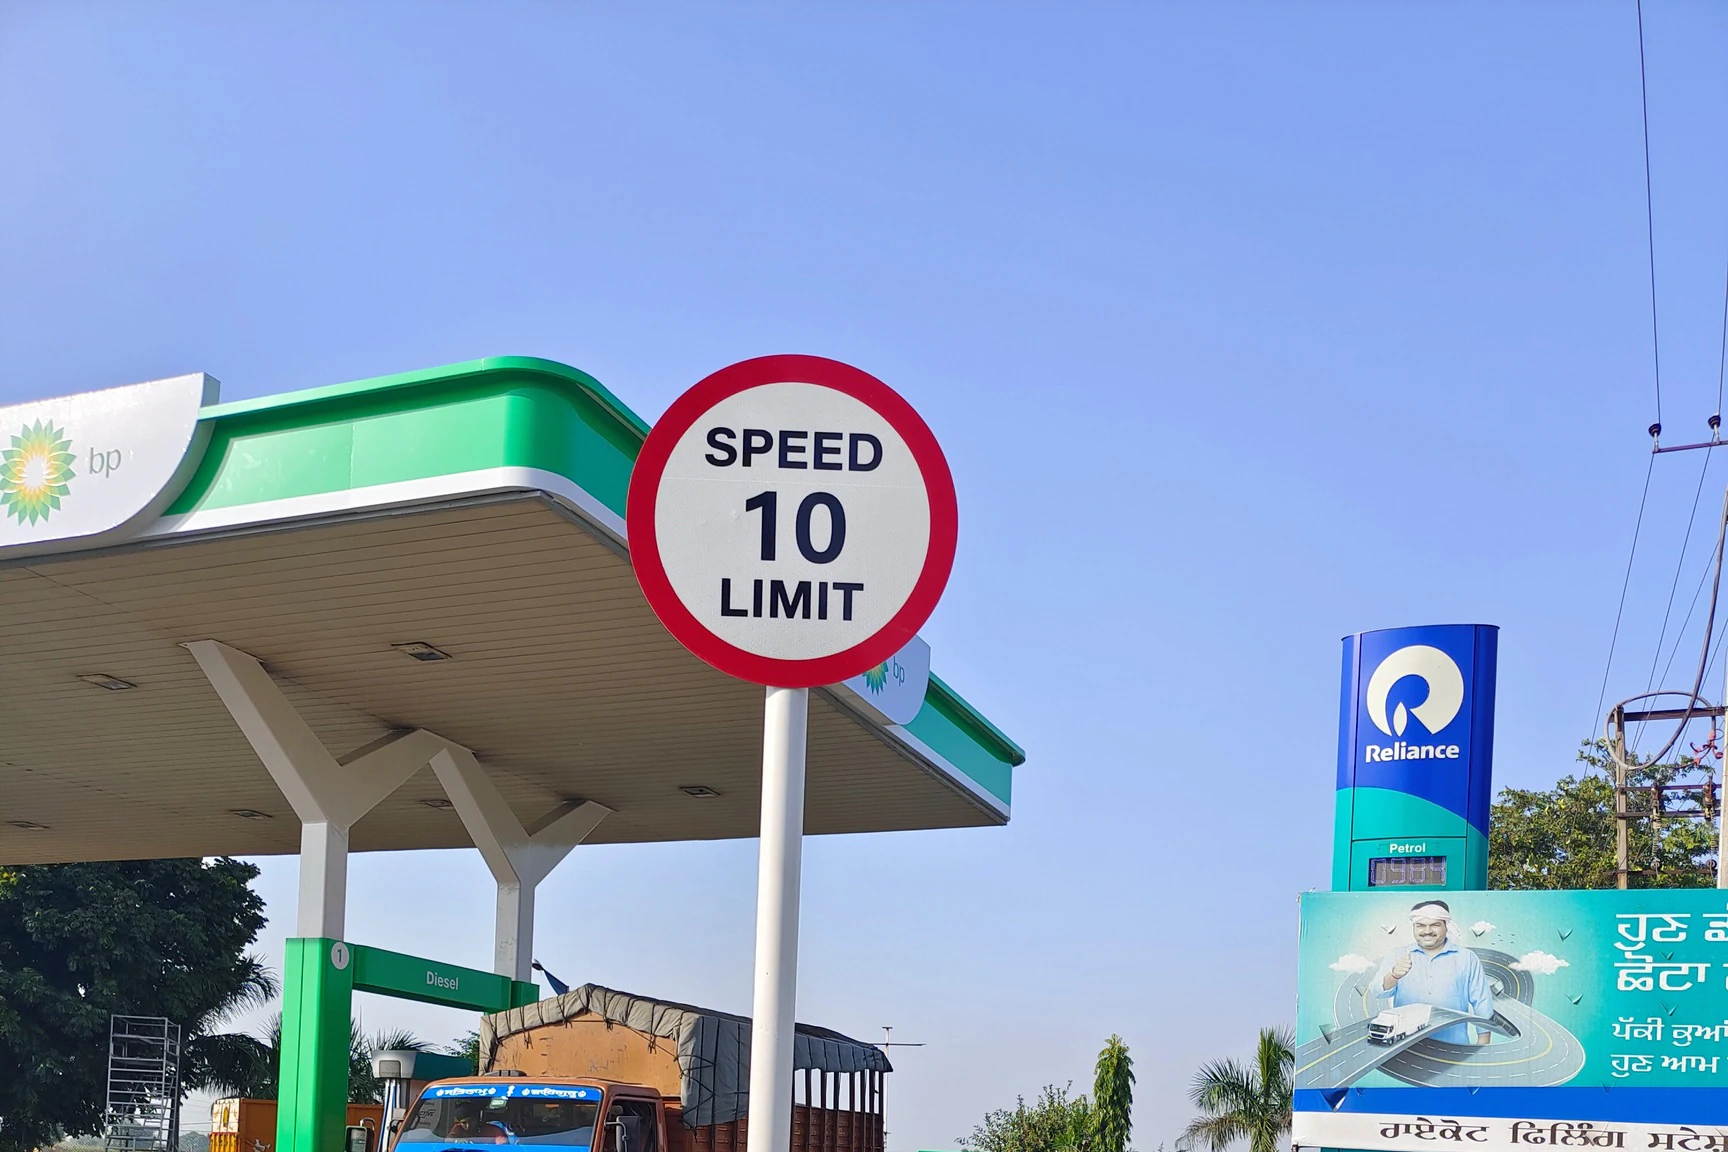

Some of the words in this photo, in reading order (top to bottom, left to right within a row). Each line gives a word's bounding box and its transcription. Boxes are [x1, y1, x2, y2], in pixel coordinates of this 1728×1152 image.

[89, 447, 122, 478] bp
[705, 427, 883, 471] SPEED
[745, 490, 846, 564] 10
[720, 578, 864, 621] LIMIT
[893, 655, 906, 687] bp
[1365, 741, 1460, 763] Reliance
[1389, 842, 1426, 854] Petrol
[1613, 913, 1692, 951] ਹੁਣ
[336, 948, 343, 964] 1
[1613, 951, 1712, 991] ਛੋਟਾ
[426, 971, 459, 991] Diesel
[1611, 1016, 1665, 1041] ਪੱਕੀ
[1610, 1053, 1655, 1078] ਹੁਣ
[1660, 1055, 1721, 1074] ਆਮ
